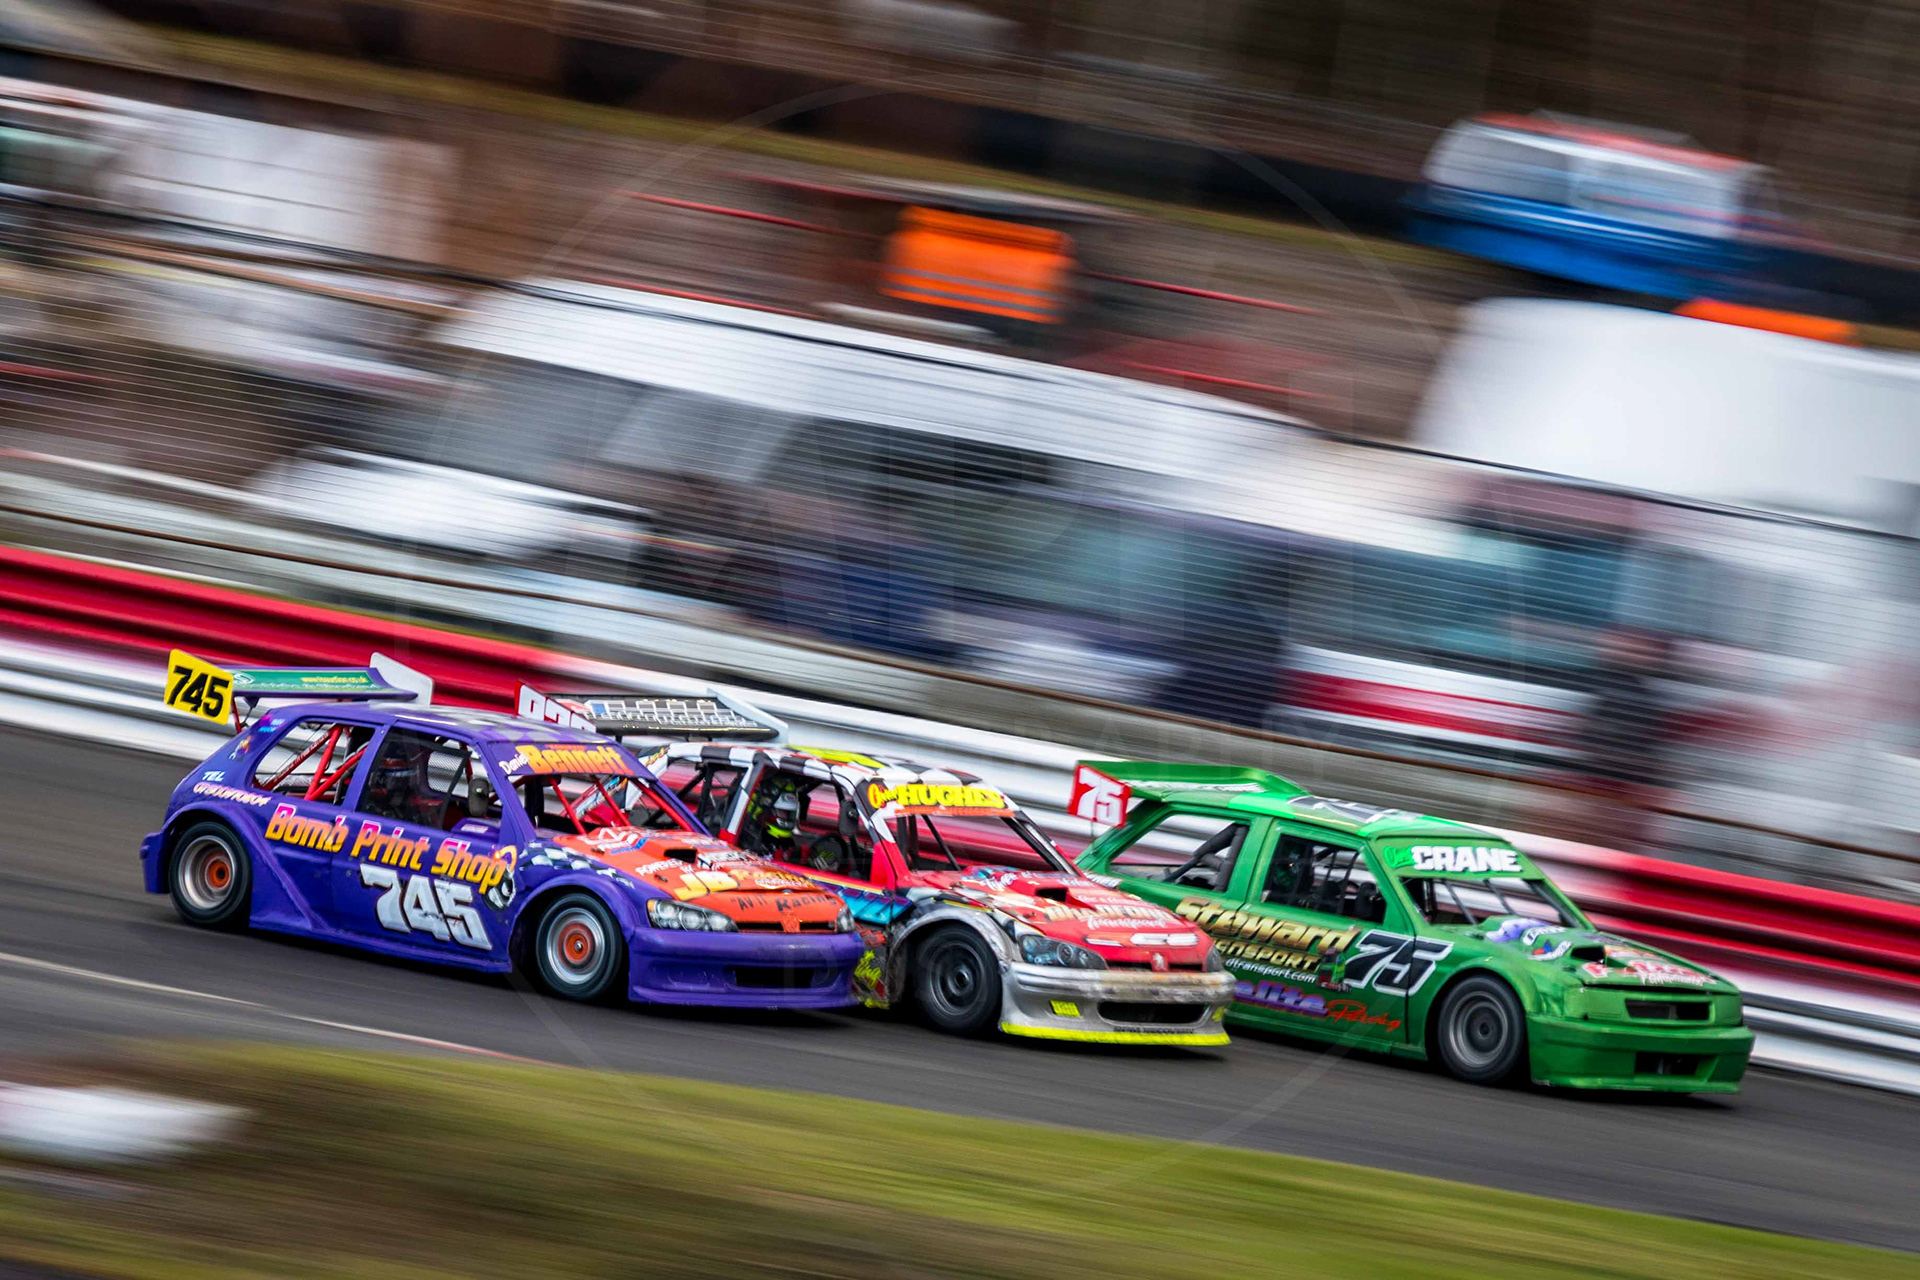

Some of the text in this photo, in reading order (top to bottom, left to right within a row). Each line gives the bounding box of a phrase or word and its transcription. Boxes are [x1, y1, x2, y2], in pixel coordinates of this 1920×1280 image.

[167, 665, 230, 718] 745
[202, 771, 225, 782] TEL
[515, 744, 634, 776] Bennett
[896, 784, 1005, 808] HUGHES
[1077, 766, 1124, 827] 75
[264, 803, 508, 895] Bomb Print Shop
[1411, 846, 1523, 873] CRANE
[360, 863, 493, 950] 745
[1175, 896, 1362, 952] Steward
[1343, 929, 1455, 996] 75
